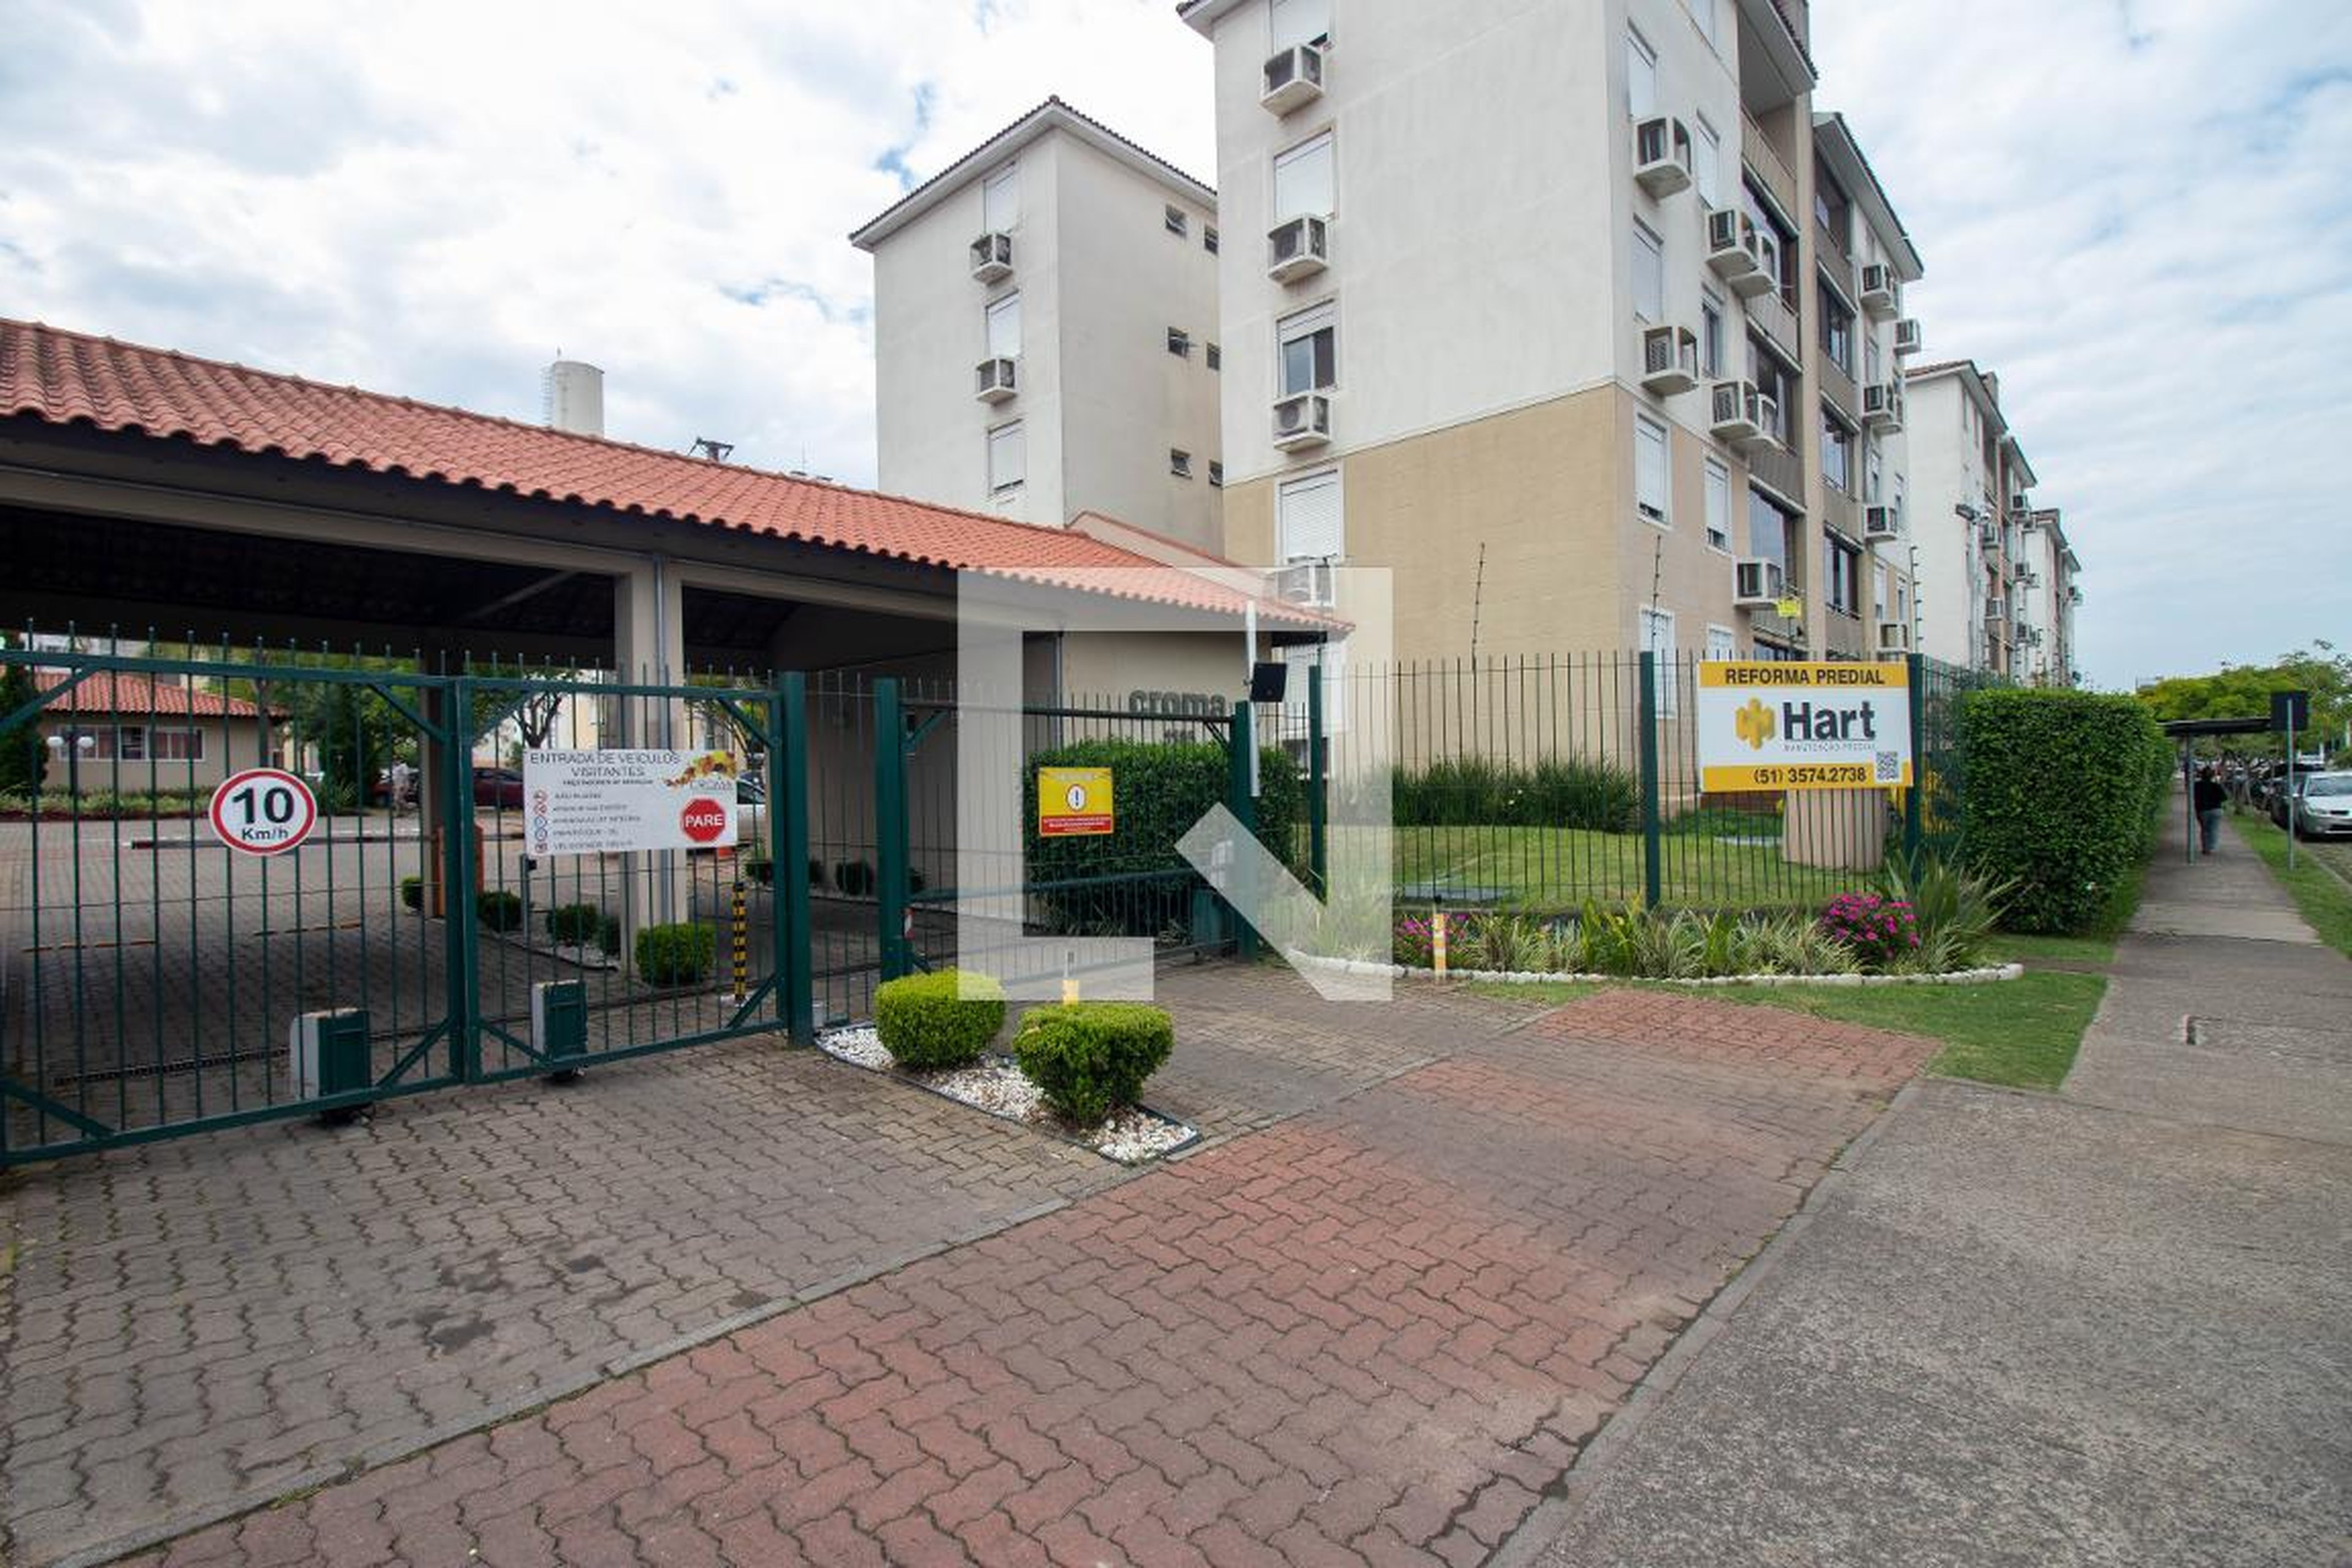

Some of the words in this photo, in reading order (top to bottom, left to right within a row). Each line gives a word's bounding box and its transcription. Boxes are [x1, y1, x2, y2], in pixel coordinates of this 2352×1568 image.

[1725, 669, 1810, 685] REFORMA
[1816, 669, 1885, 685] PREDIAL
[1782, 701, 1876, 740] Hart
[530, 753, 592, 764] ENTRADA
[598, 753, 614, 764] DE
[571, 767, 645, 777] VISITANTES
[1754, 769, 1784, 784] (51)
[1788, 767, 1866, 783] 3574.2738
[232, 787, 295, 824] 10
[685, 813, 724, 827] PARE
[242, 827, 288, 840] Km/h
